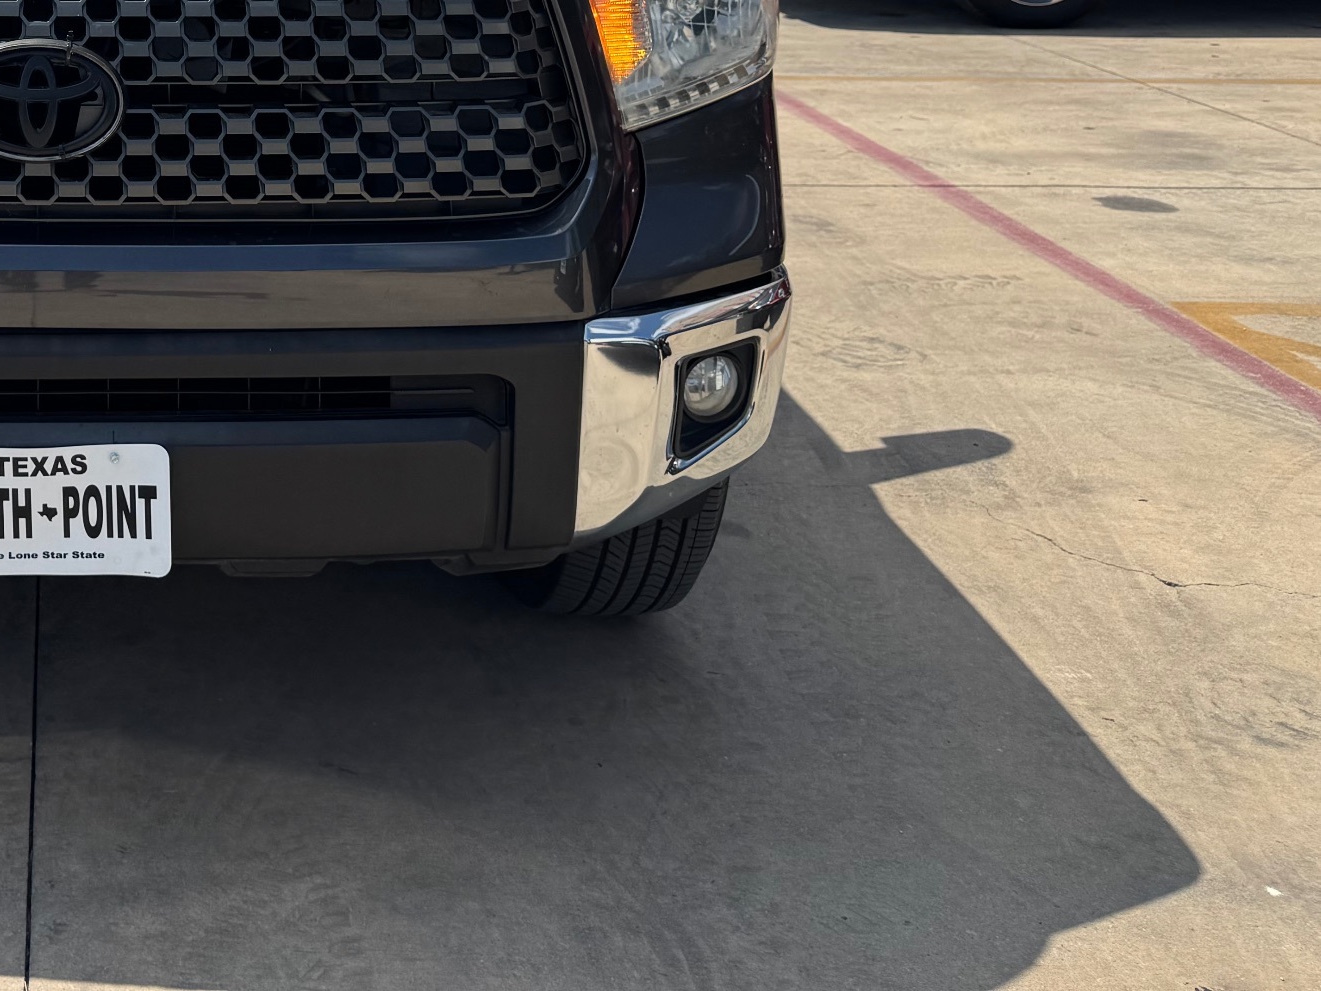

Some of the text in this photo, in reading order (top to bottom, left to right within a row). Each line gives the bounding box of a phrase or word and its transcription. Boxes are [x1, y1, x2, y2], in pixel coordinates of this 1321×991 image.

[62, 484, 157, 539] POINT
[8, 551, 38, 560] Lone
[42, 551, 68, 559] Star
[72, 550, 105, 559] State
